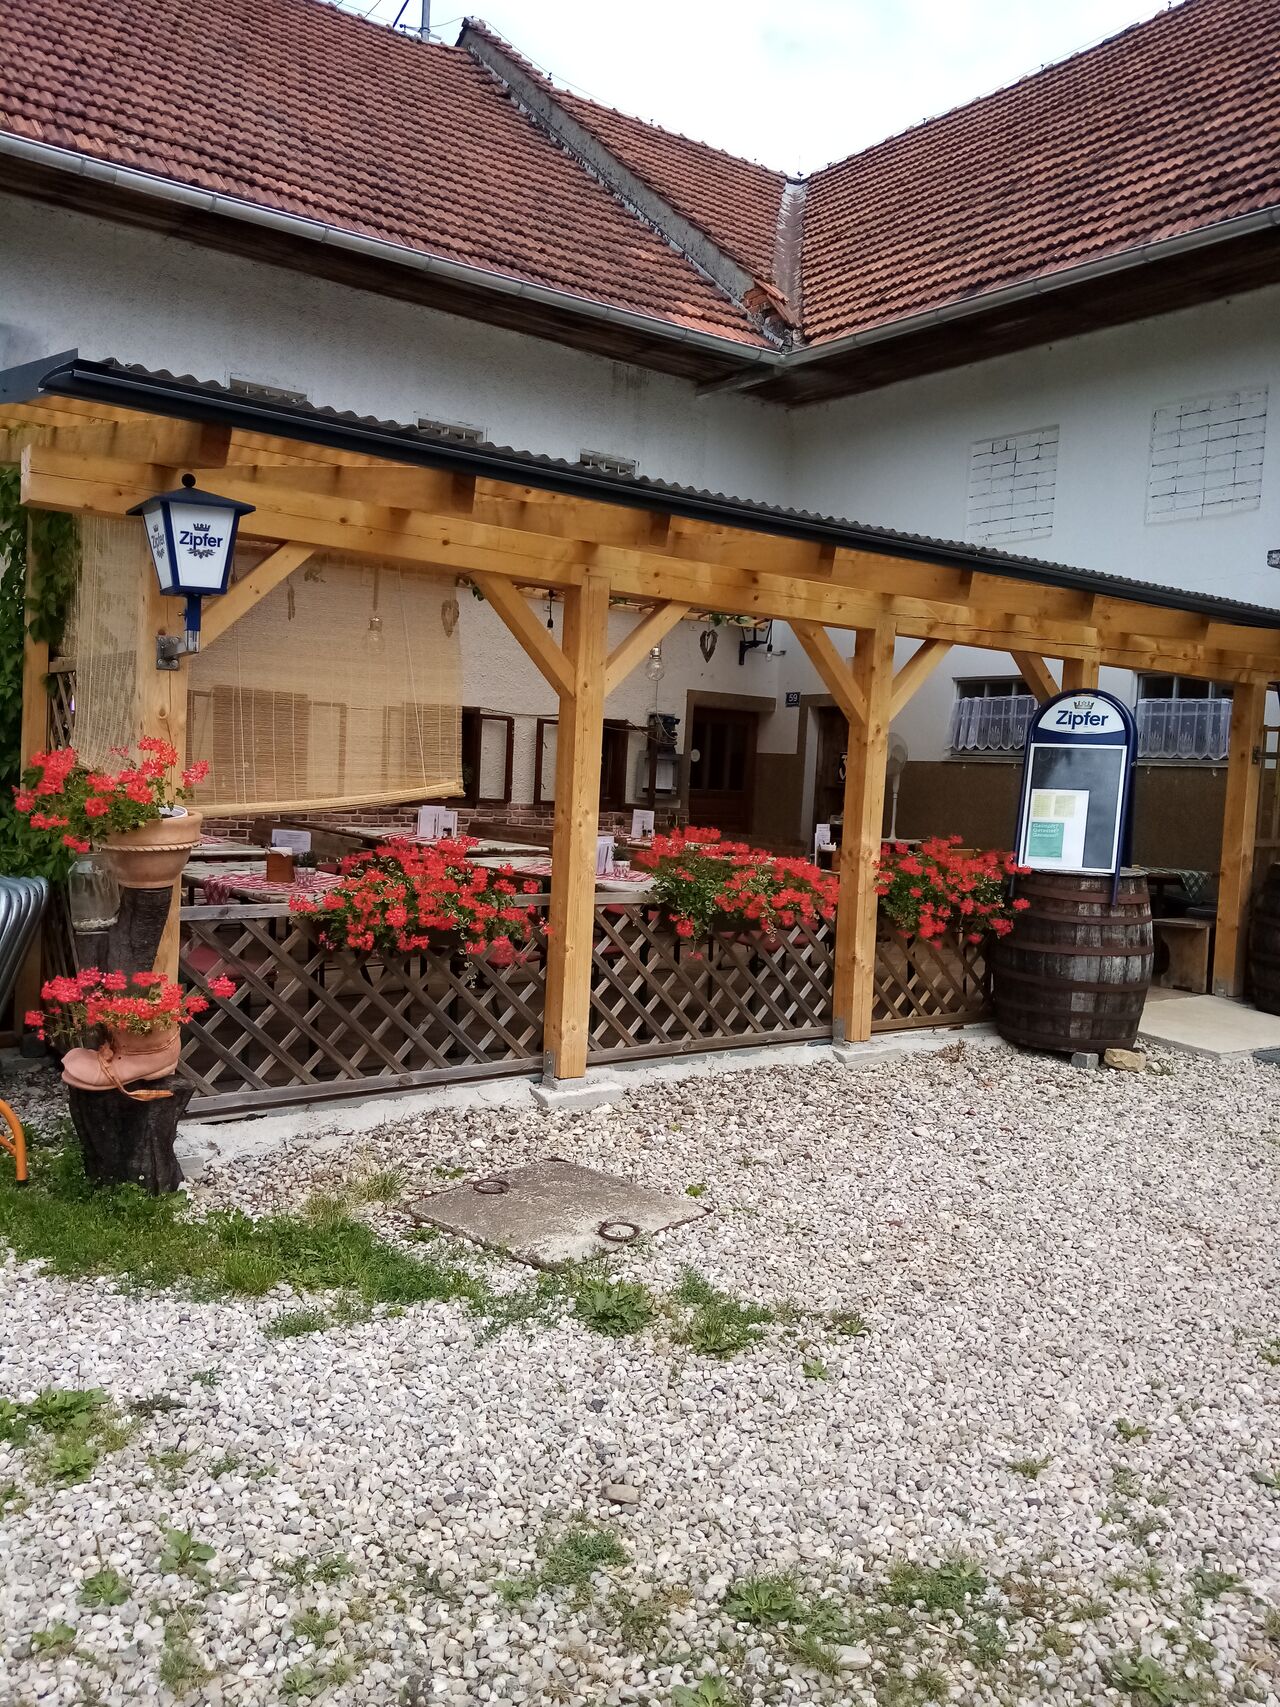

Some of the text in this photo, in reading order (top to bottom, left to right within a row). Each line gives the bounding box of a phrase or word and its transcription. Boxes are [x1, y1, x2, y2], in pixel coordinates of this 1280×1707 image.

[179, 530, 223, 549] Zipfer
[788, 693, 798, 702] 59
[1056, 710, 1109, 730] Zipfer
